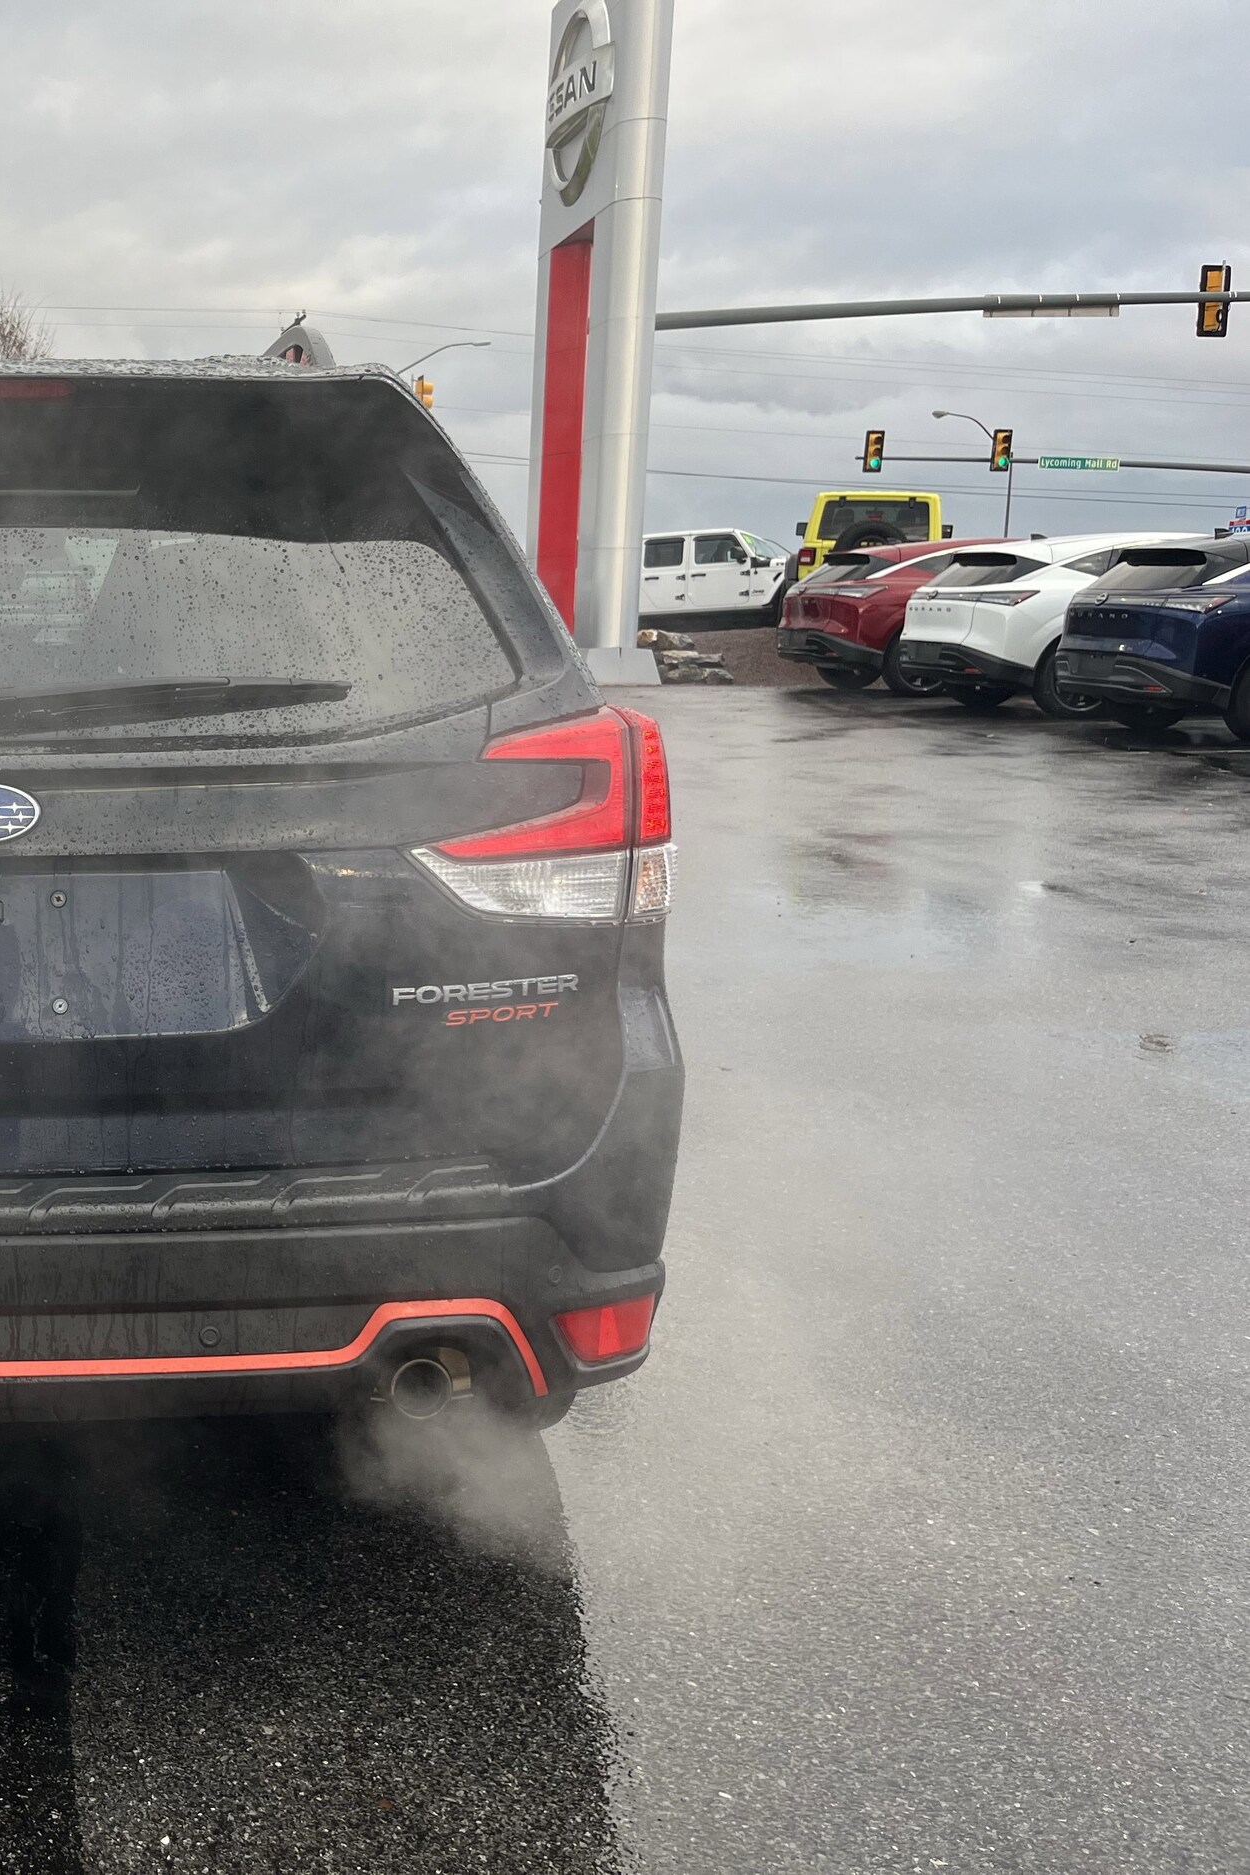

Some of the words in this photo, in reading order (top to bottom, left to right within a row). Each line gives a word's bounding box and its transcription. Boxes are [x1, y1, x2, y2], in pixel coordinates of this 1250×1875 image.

[1041, 458, 1082, 469] Lycoming
[1085, 459, 1103, 468] Mall
[1106, 460, 1117, 468] Rd
[392, 974, 579, 1006] FORESTER
[445, 1002, 559, 1026] SPORT
